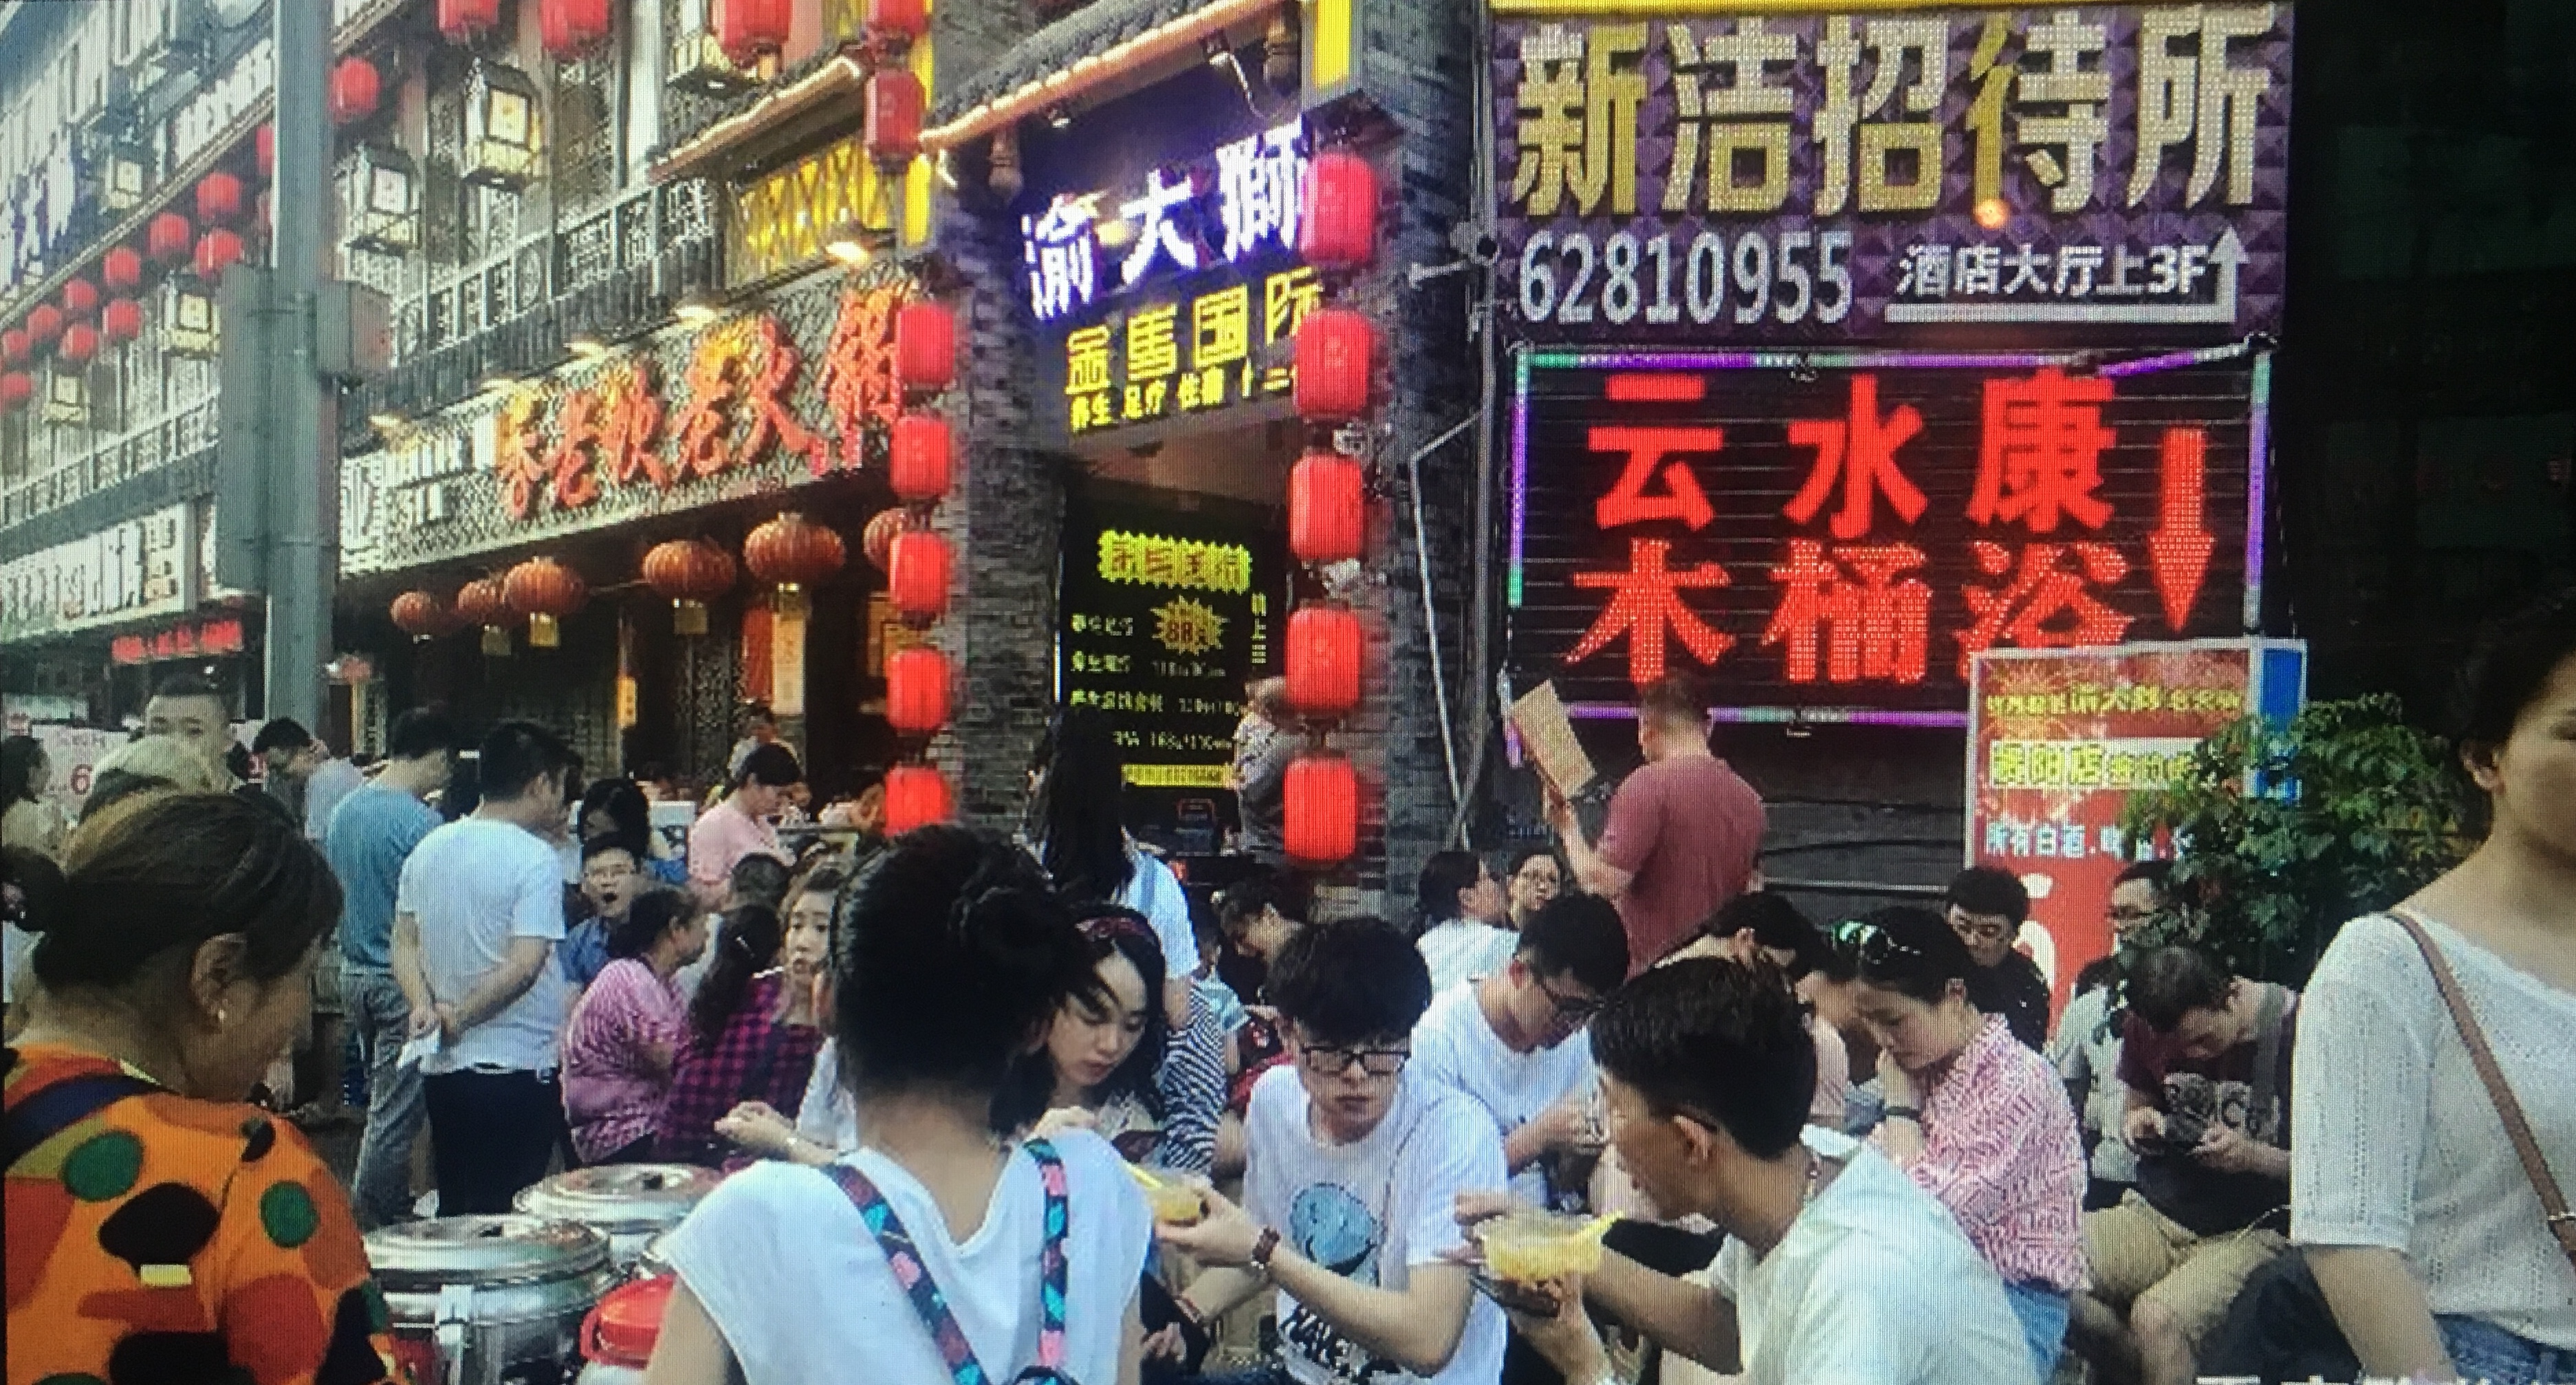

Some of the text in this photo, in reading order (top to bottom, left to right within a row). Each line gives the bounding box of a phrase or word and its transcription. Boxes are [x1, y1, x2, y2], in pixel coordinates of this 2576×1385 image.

[1512, 3, 2275, 217] 新洁招待所
[1517, 230, 1854, 326] 62810955
[1896, 242, 2209, 297] 酒店大厅上3F
[1587, 364, 2117, 539] 云水康
[1564, 537, 2136, 684] 木桶浴
